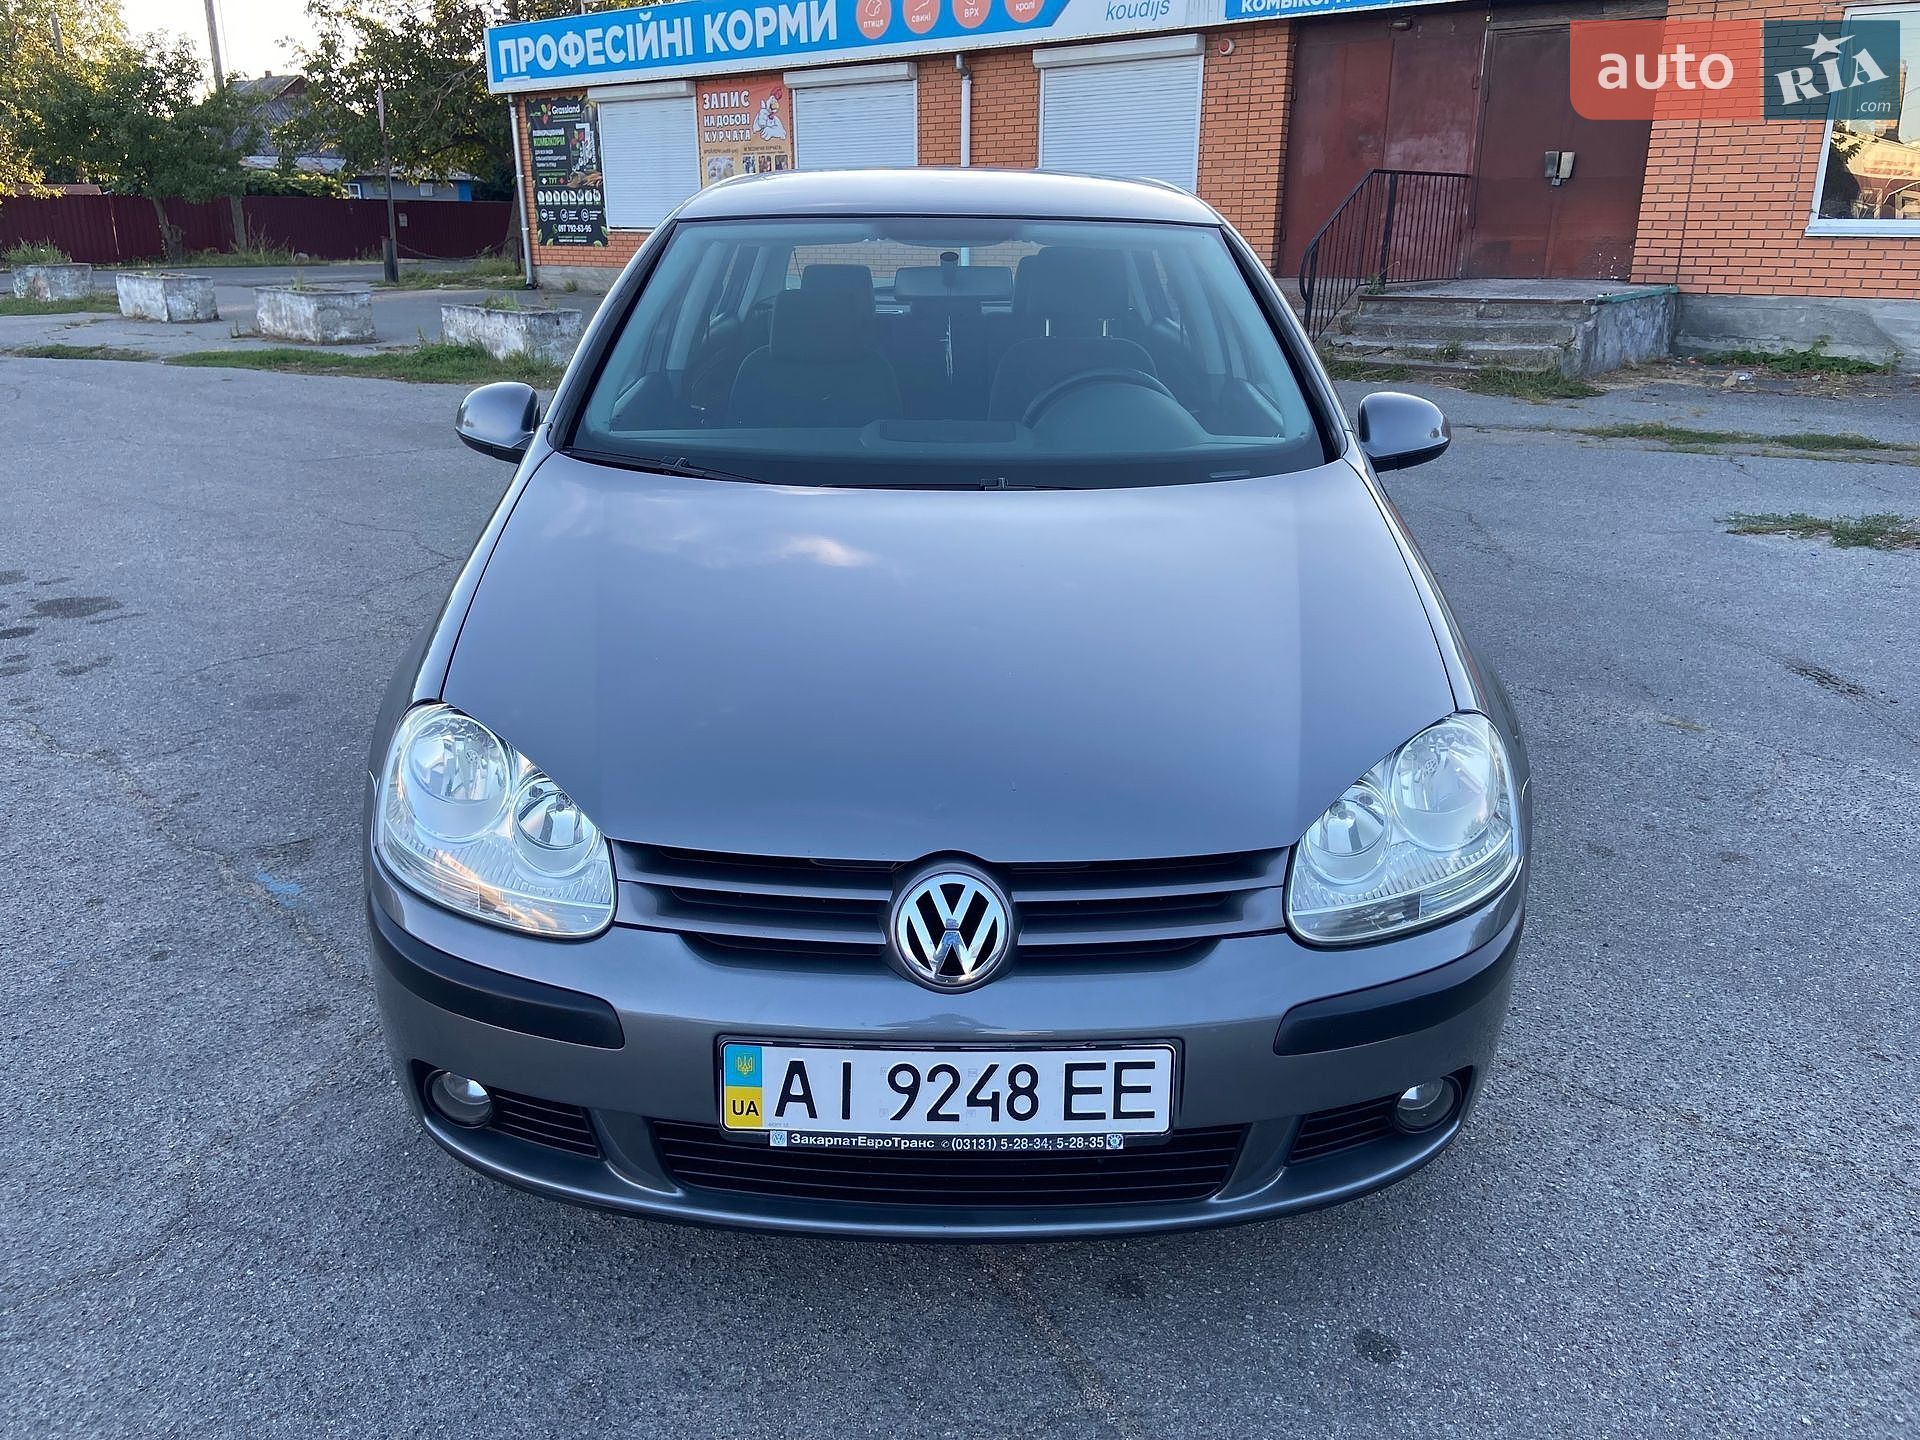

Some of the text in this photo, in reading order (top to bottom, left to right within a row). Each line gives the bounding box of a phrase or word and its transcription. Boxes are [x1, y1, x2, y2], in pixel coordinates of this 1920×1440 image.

[911, 12, 931, 22] свині
[964, 8, 979, 18] ВРХ
[863, 19, 884, 28] птиця
[498, 0, 837, 75] ПРОФЕСІЙНІ КОРМИ
[702, 90, 750, 110] ЗАПИС
[552, 104, 580, 114] Grassland
[704, 113, 750, 128] НА ДОБОВІ
[704, 129, 751, 143] КУРЧАТА
[774, 1060, 1156, 1122] AI 9248 EE
[732, 1100, 759, 1117] UA
[791, 1133, 1104, 1151] ЗакарпатЕвроТранс (03131) 5-28-34; 5-28-35
